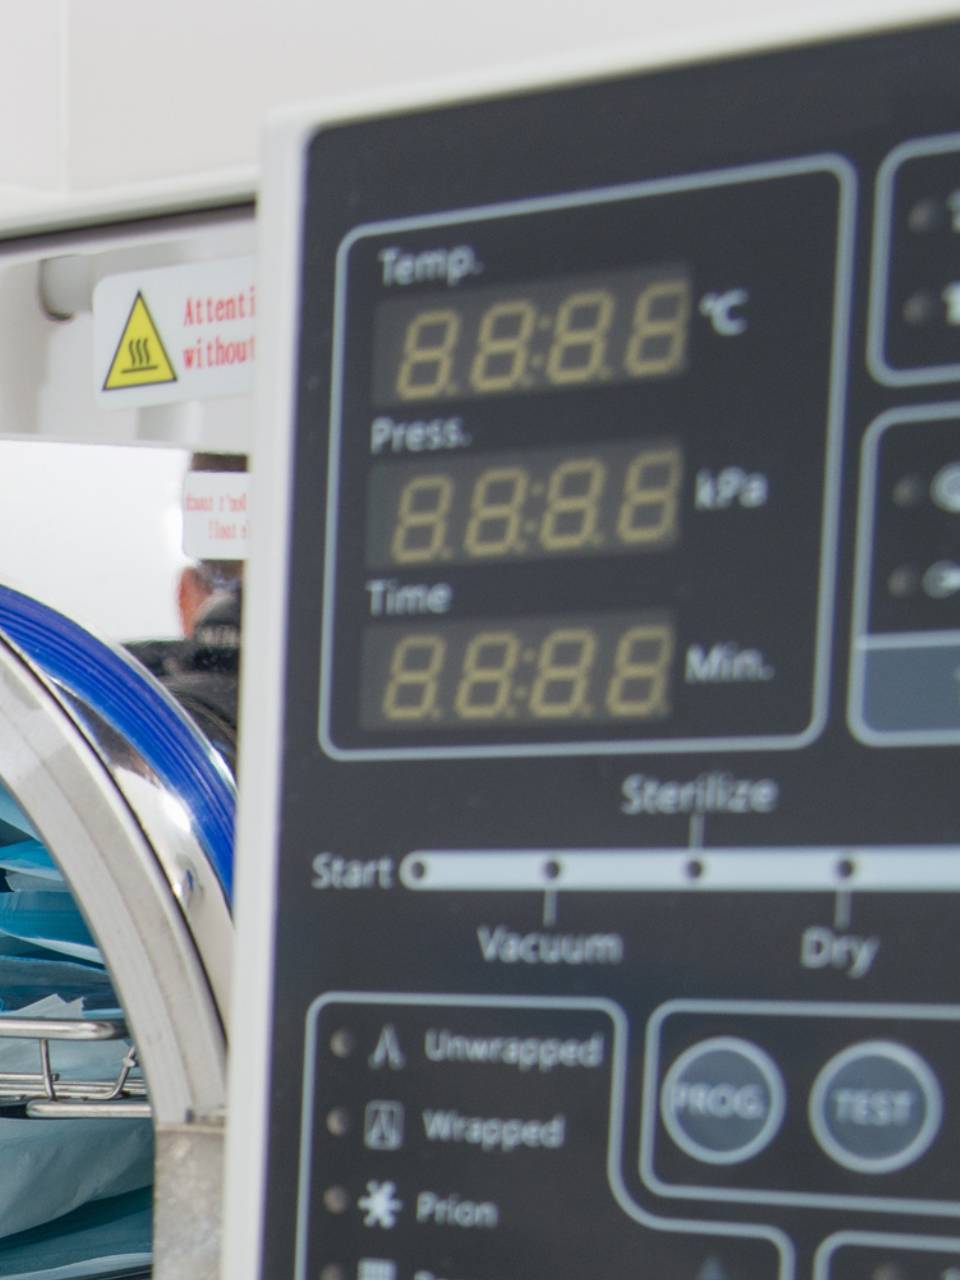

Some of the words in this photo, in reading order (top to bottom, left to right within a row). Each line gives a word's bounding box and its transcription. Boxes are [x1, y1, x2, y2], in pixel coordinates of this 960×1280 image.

[378, 245, 484, 287] Temp.
[370, 416, 471, 454] Press.
[694, 465, 769, 511] kPa
[366, 578, 453, 616] Time
[684, 641, 776, 684] Min.
[621, 773, 778, 815] Sterilize
[312, 851, 394, 890] Start
[477, 926, 624, 965] Vacuum
[800, 926, 878, 977] Dry
[424, 1029, 604, 1073] Unwrapped
[672, 1081, 763, 1120] PROG
[836, 1087, 914, 1127] TEST
[423, 1109, 566, 1150] Wrapped
[417, 1191, 498, 1229] Prion
